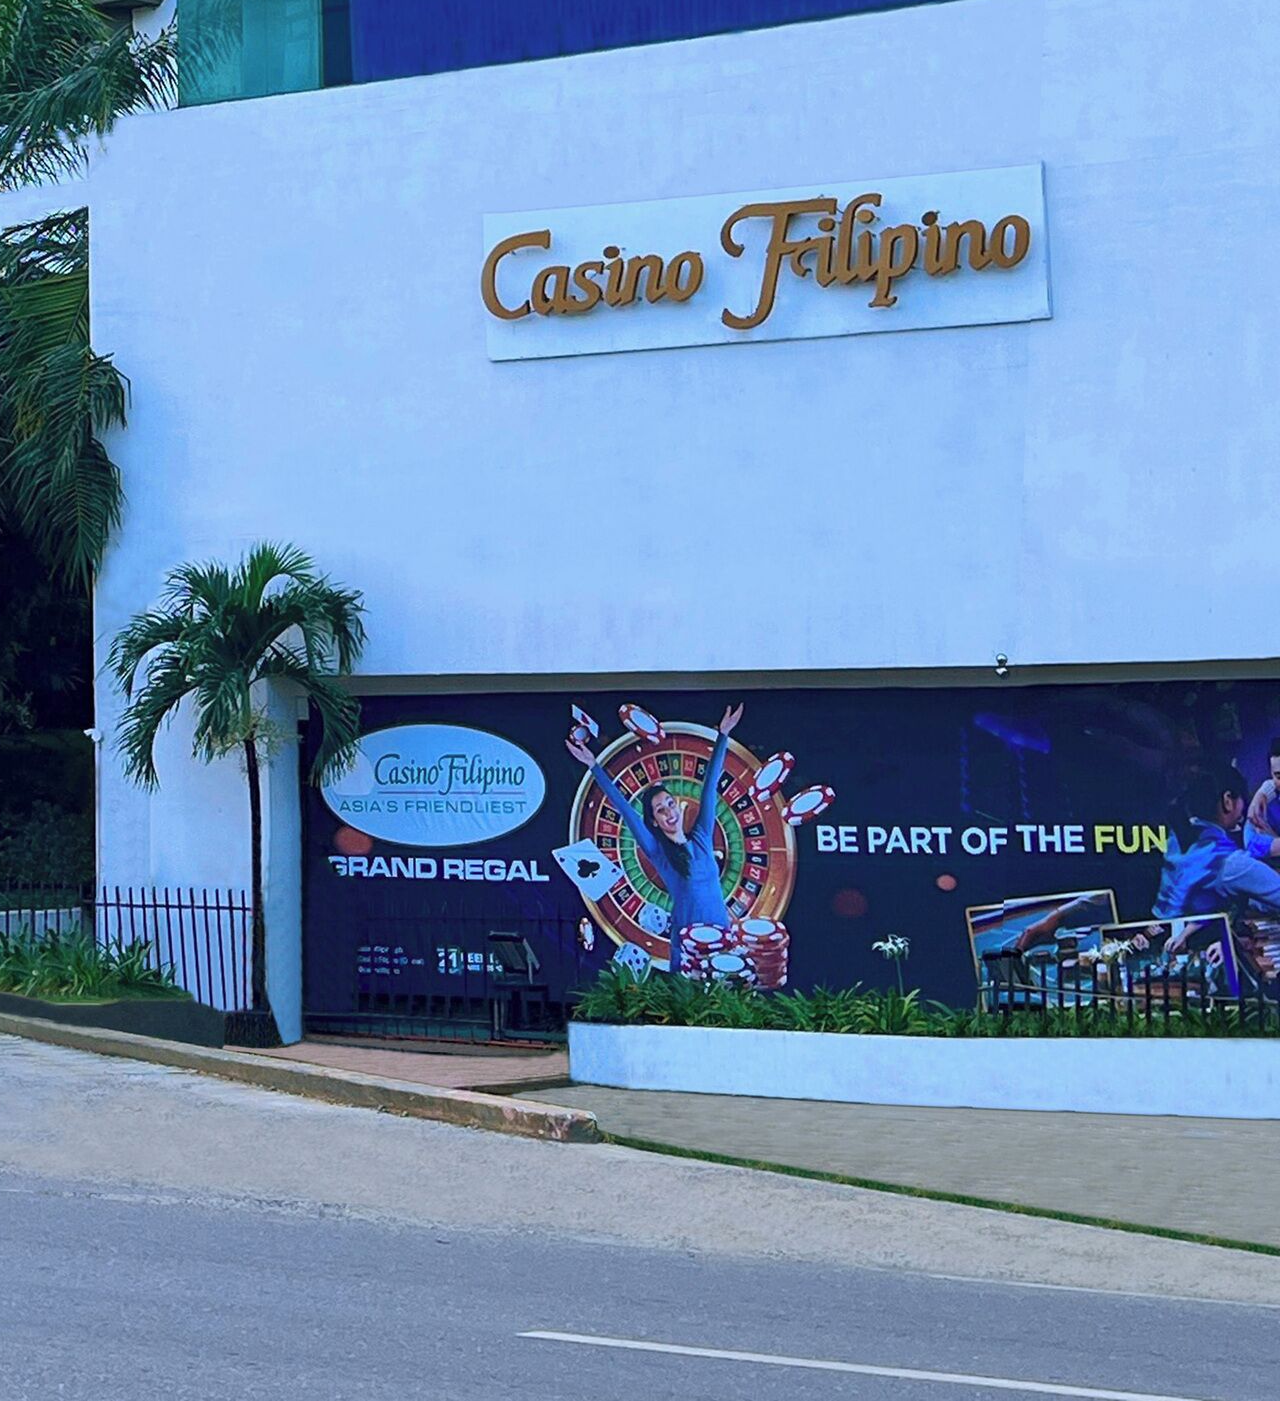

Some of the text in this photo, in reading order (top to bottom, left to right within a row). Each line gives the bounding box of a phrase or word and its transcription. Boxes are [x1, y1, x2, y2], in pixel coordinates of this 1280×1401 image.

[481, 192, 1031, 330] Casino Filipino
[374, 753, 525, 796] Casino Filipino
[339, 800, 528, 815] ASIA'S FRIENDLIEST
[816, 824, 1167, 855] BE PART OF THE FUN
[328, 855, 550, 882] GRAND REGAL
